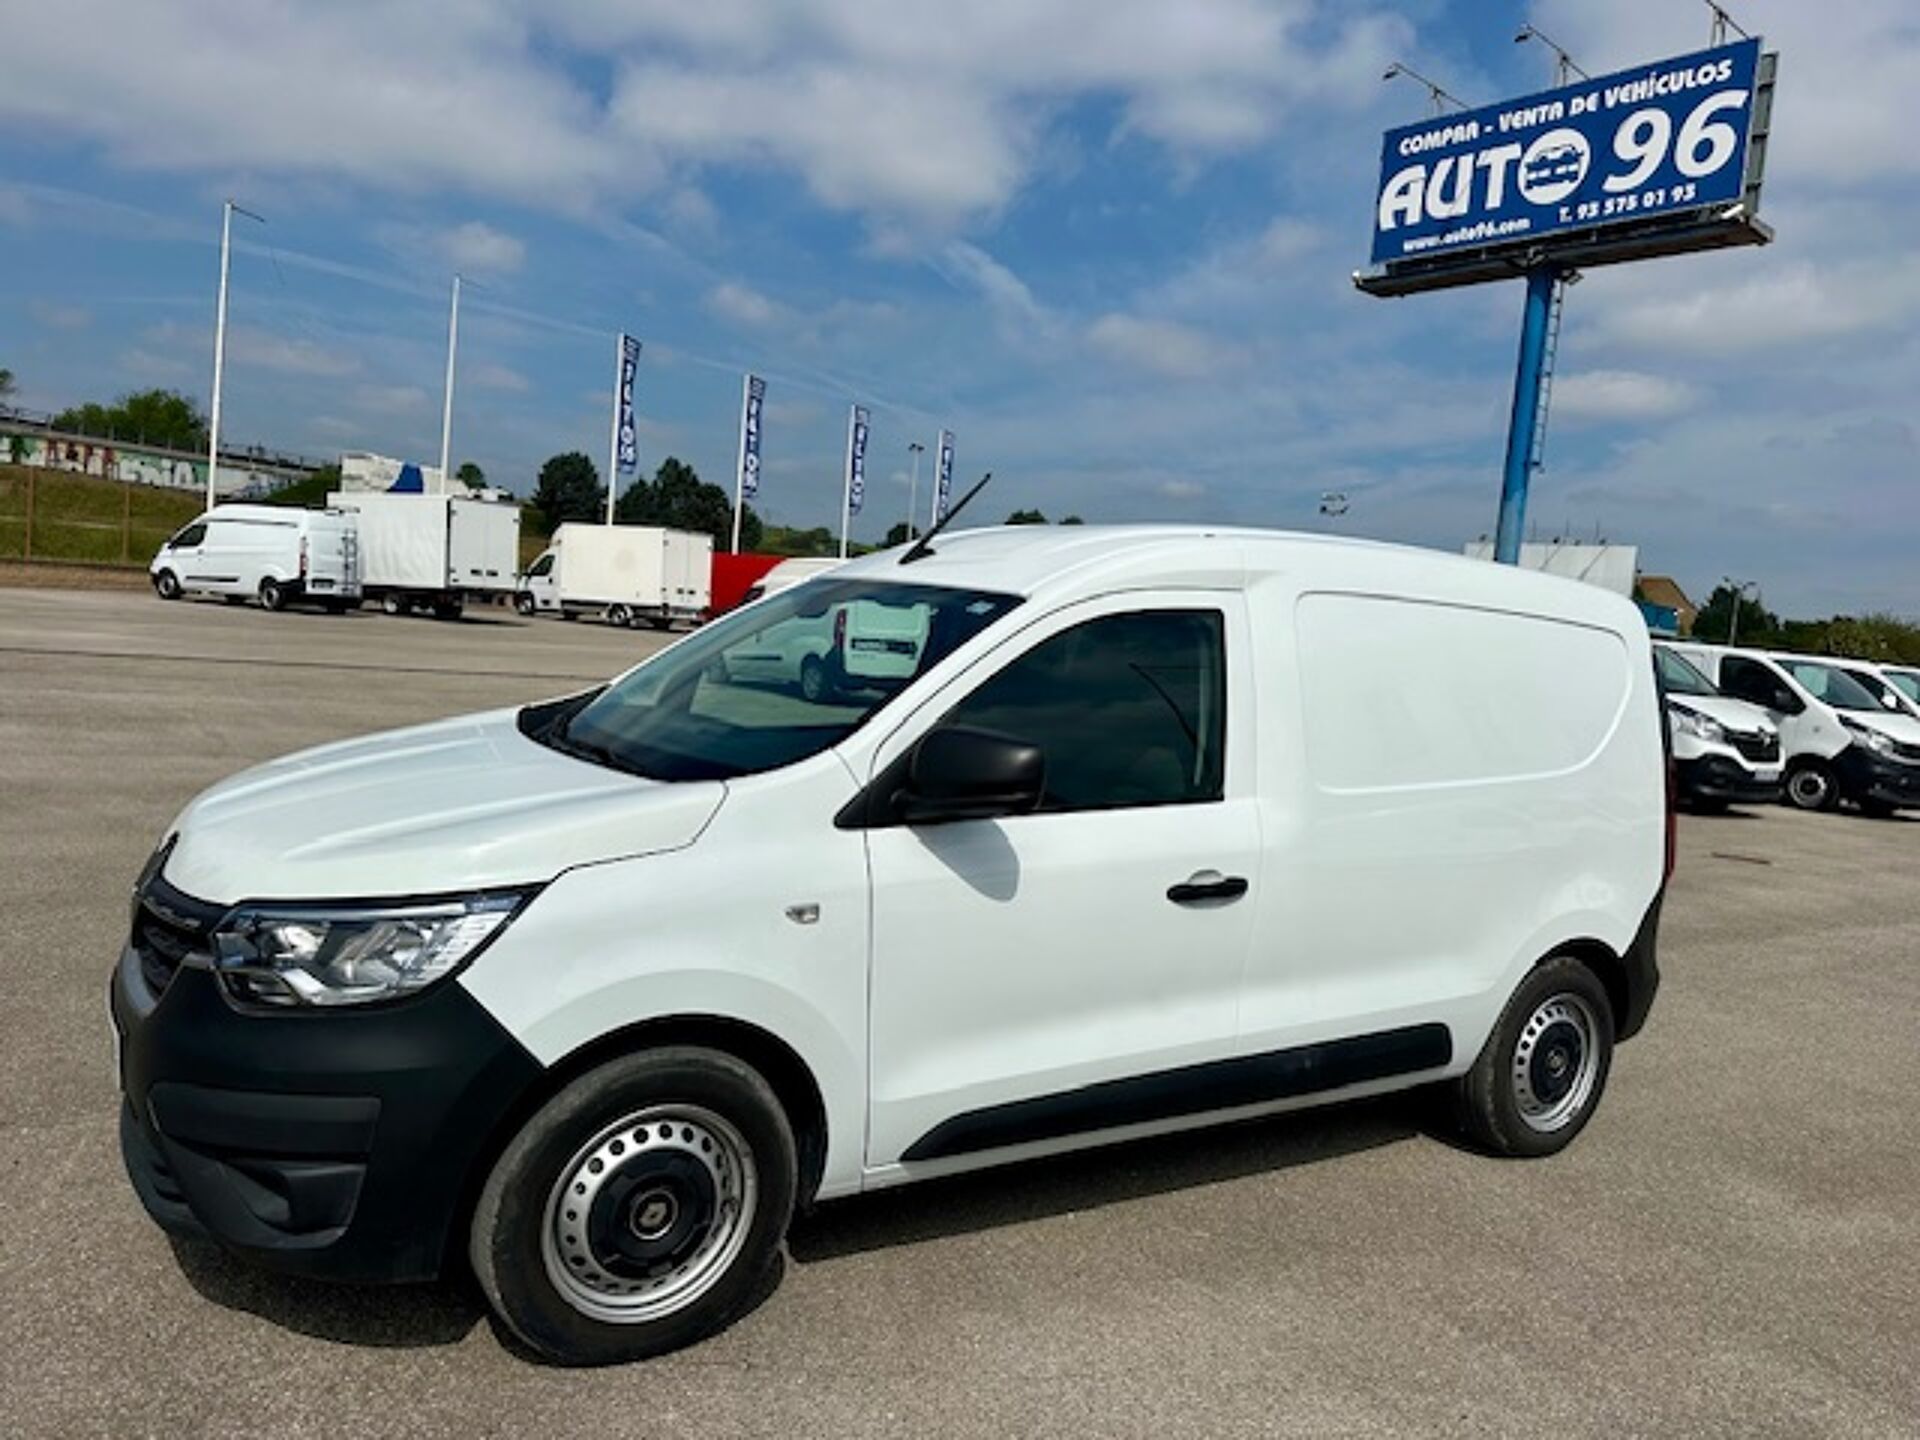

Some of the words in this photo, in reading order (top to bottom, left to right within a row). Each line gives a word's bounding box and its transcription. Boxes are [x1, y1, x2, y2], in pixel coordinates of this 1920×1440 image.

[1399, 121, 1479, 156] COMPRA
[1499, 101, 1564, 132] VENTA
[1569, 92, 1599, 116] DE
[1604, 59, 1732, 108] VEHÍCULOS
[1379, 128, 1591, 231] AUTO
[1602, 89, 1749, 192] 96
[1642, 189, 1665, 208] 01
[1403, 217, 1531, 252] www.auto96.com
